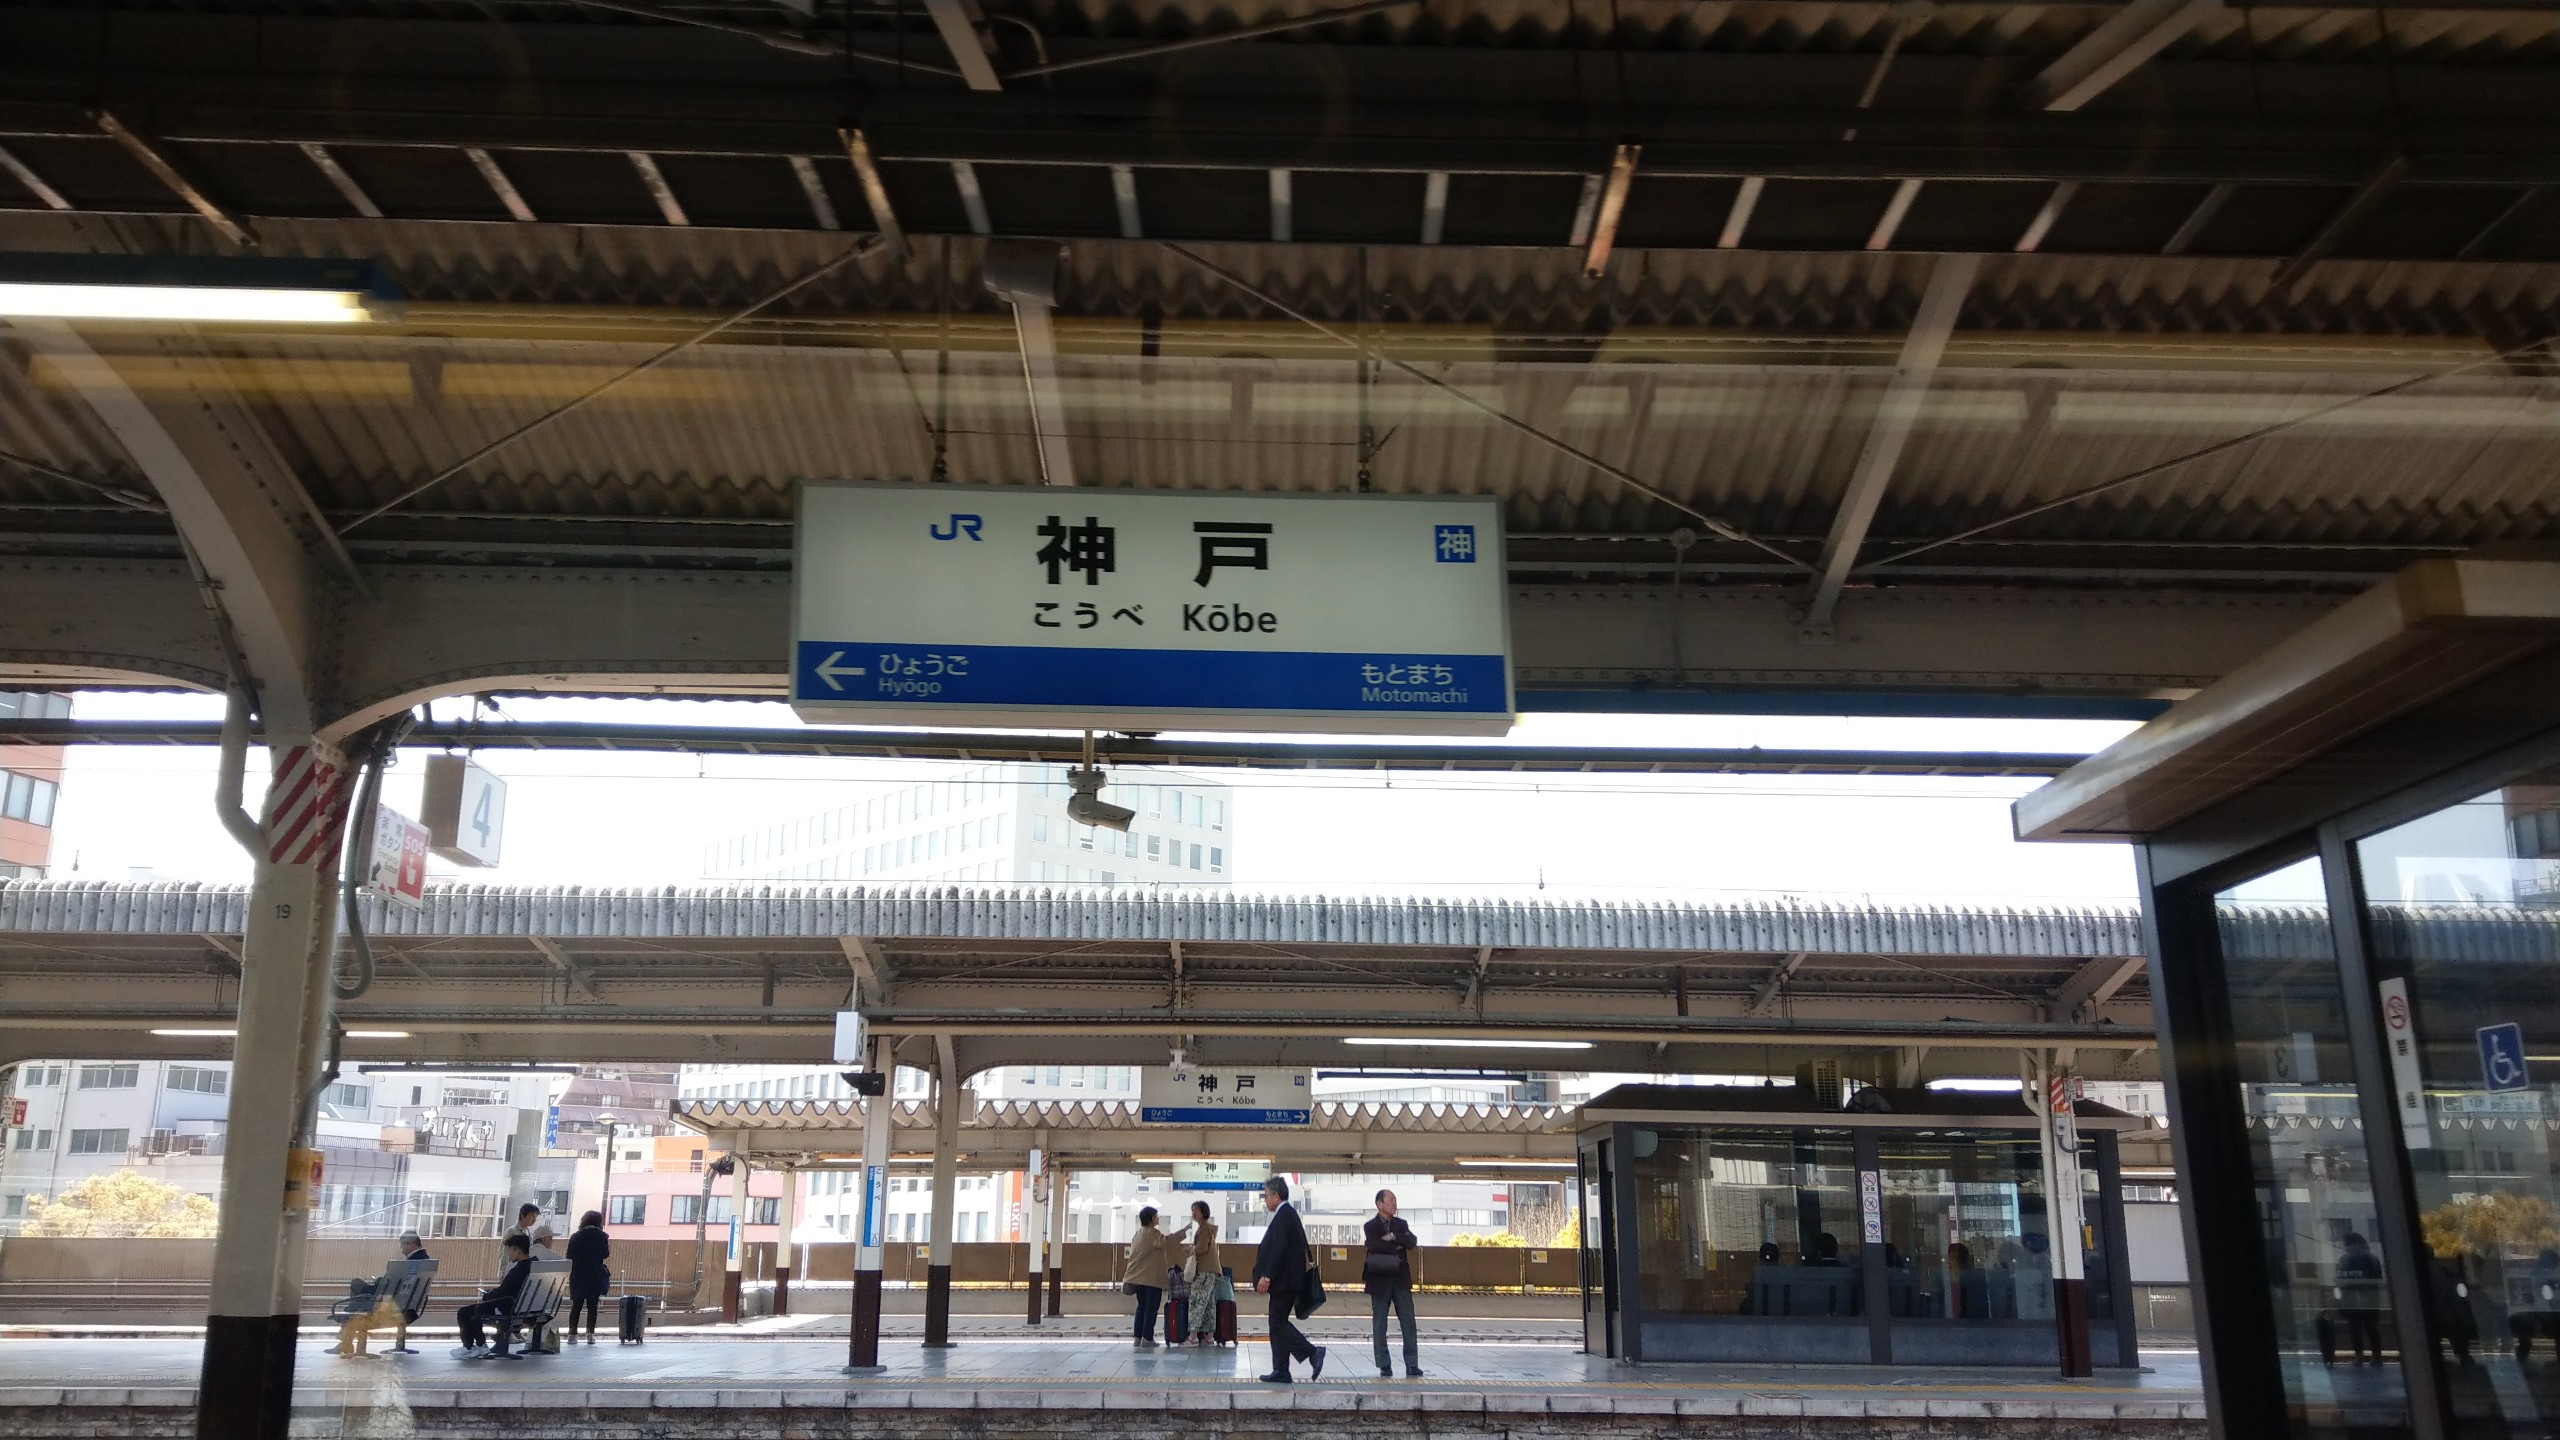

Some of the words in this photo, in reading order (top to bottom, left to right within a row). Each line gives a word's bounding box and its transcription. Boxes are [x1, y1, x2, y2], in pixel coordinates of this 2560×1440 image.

[930, 513, 984, 541] JR
[1036, 515, 1273, 588] 神戸
[1438, 528, 1472, 560] 神
[1034, 602, 1145, 629] こうべ
[879, 653, 969, 676] ひょうご
[1361, 662, 1453, 685] もとまち
[1361, 687, 1468, 703] Motomachi
[471, 782, 492, 849] 4
[404, 835, 425, 857] SOS
[275, 903, 291, 919] 19
[1011, 1202, 1021, 1232] LIXIL
